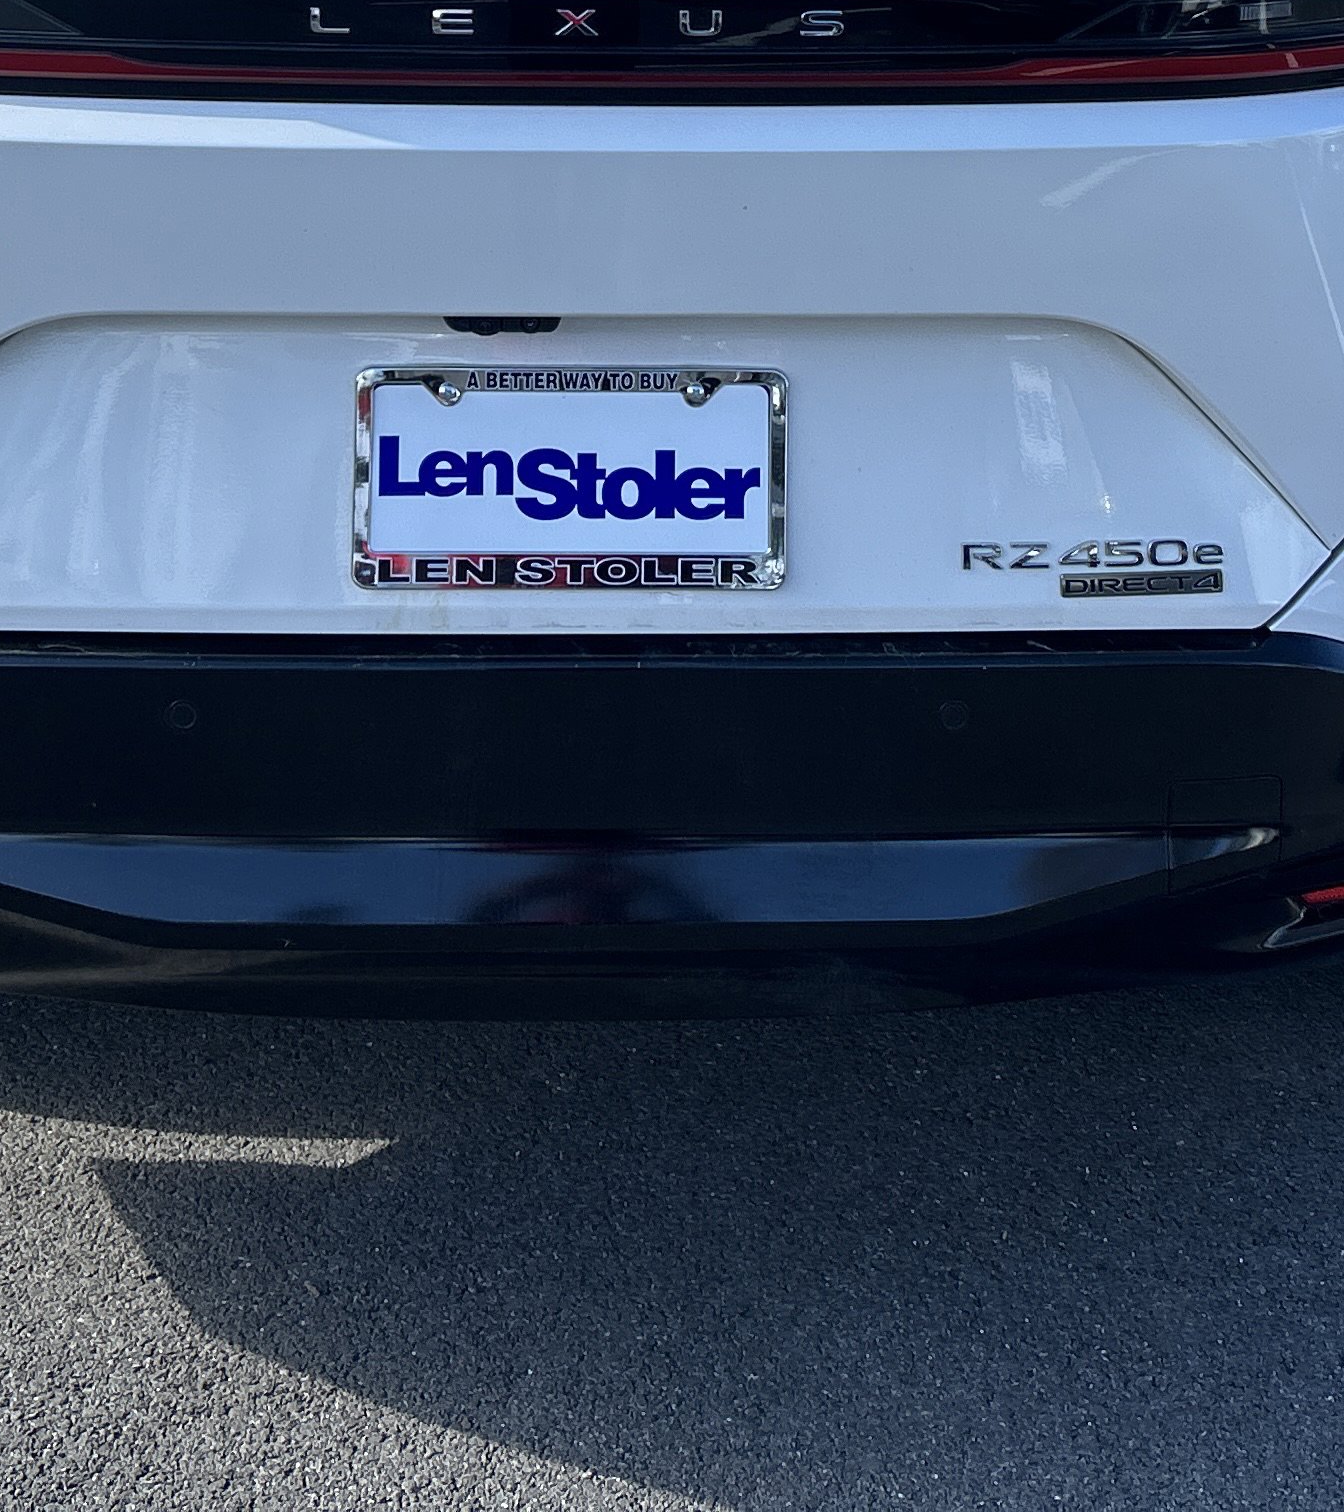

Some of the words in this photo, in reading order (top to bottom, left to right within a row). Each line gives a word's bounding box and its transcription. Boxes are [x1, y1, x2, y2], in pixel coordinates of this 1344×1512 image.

[309, 7, 845, 37] LEXUS
[467, 371, 479, 390] A
[485, 371, 559, 390] BETTER
[559, 372, 606, 390] WAY
[608, 372, 634, 390] TO
[640, 372, 678, 390] BUY
[376, 556, 496, 586] LEN
[515, 556, 761, 586] STOLER
